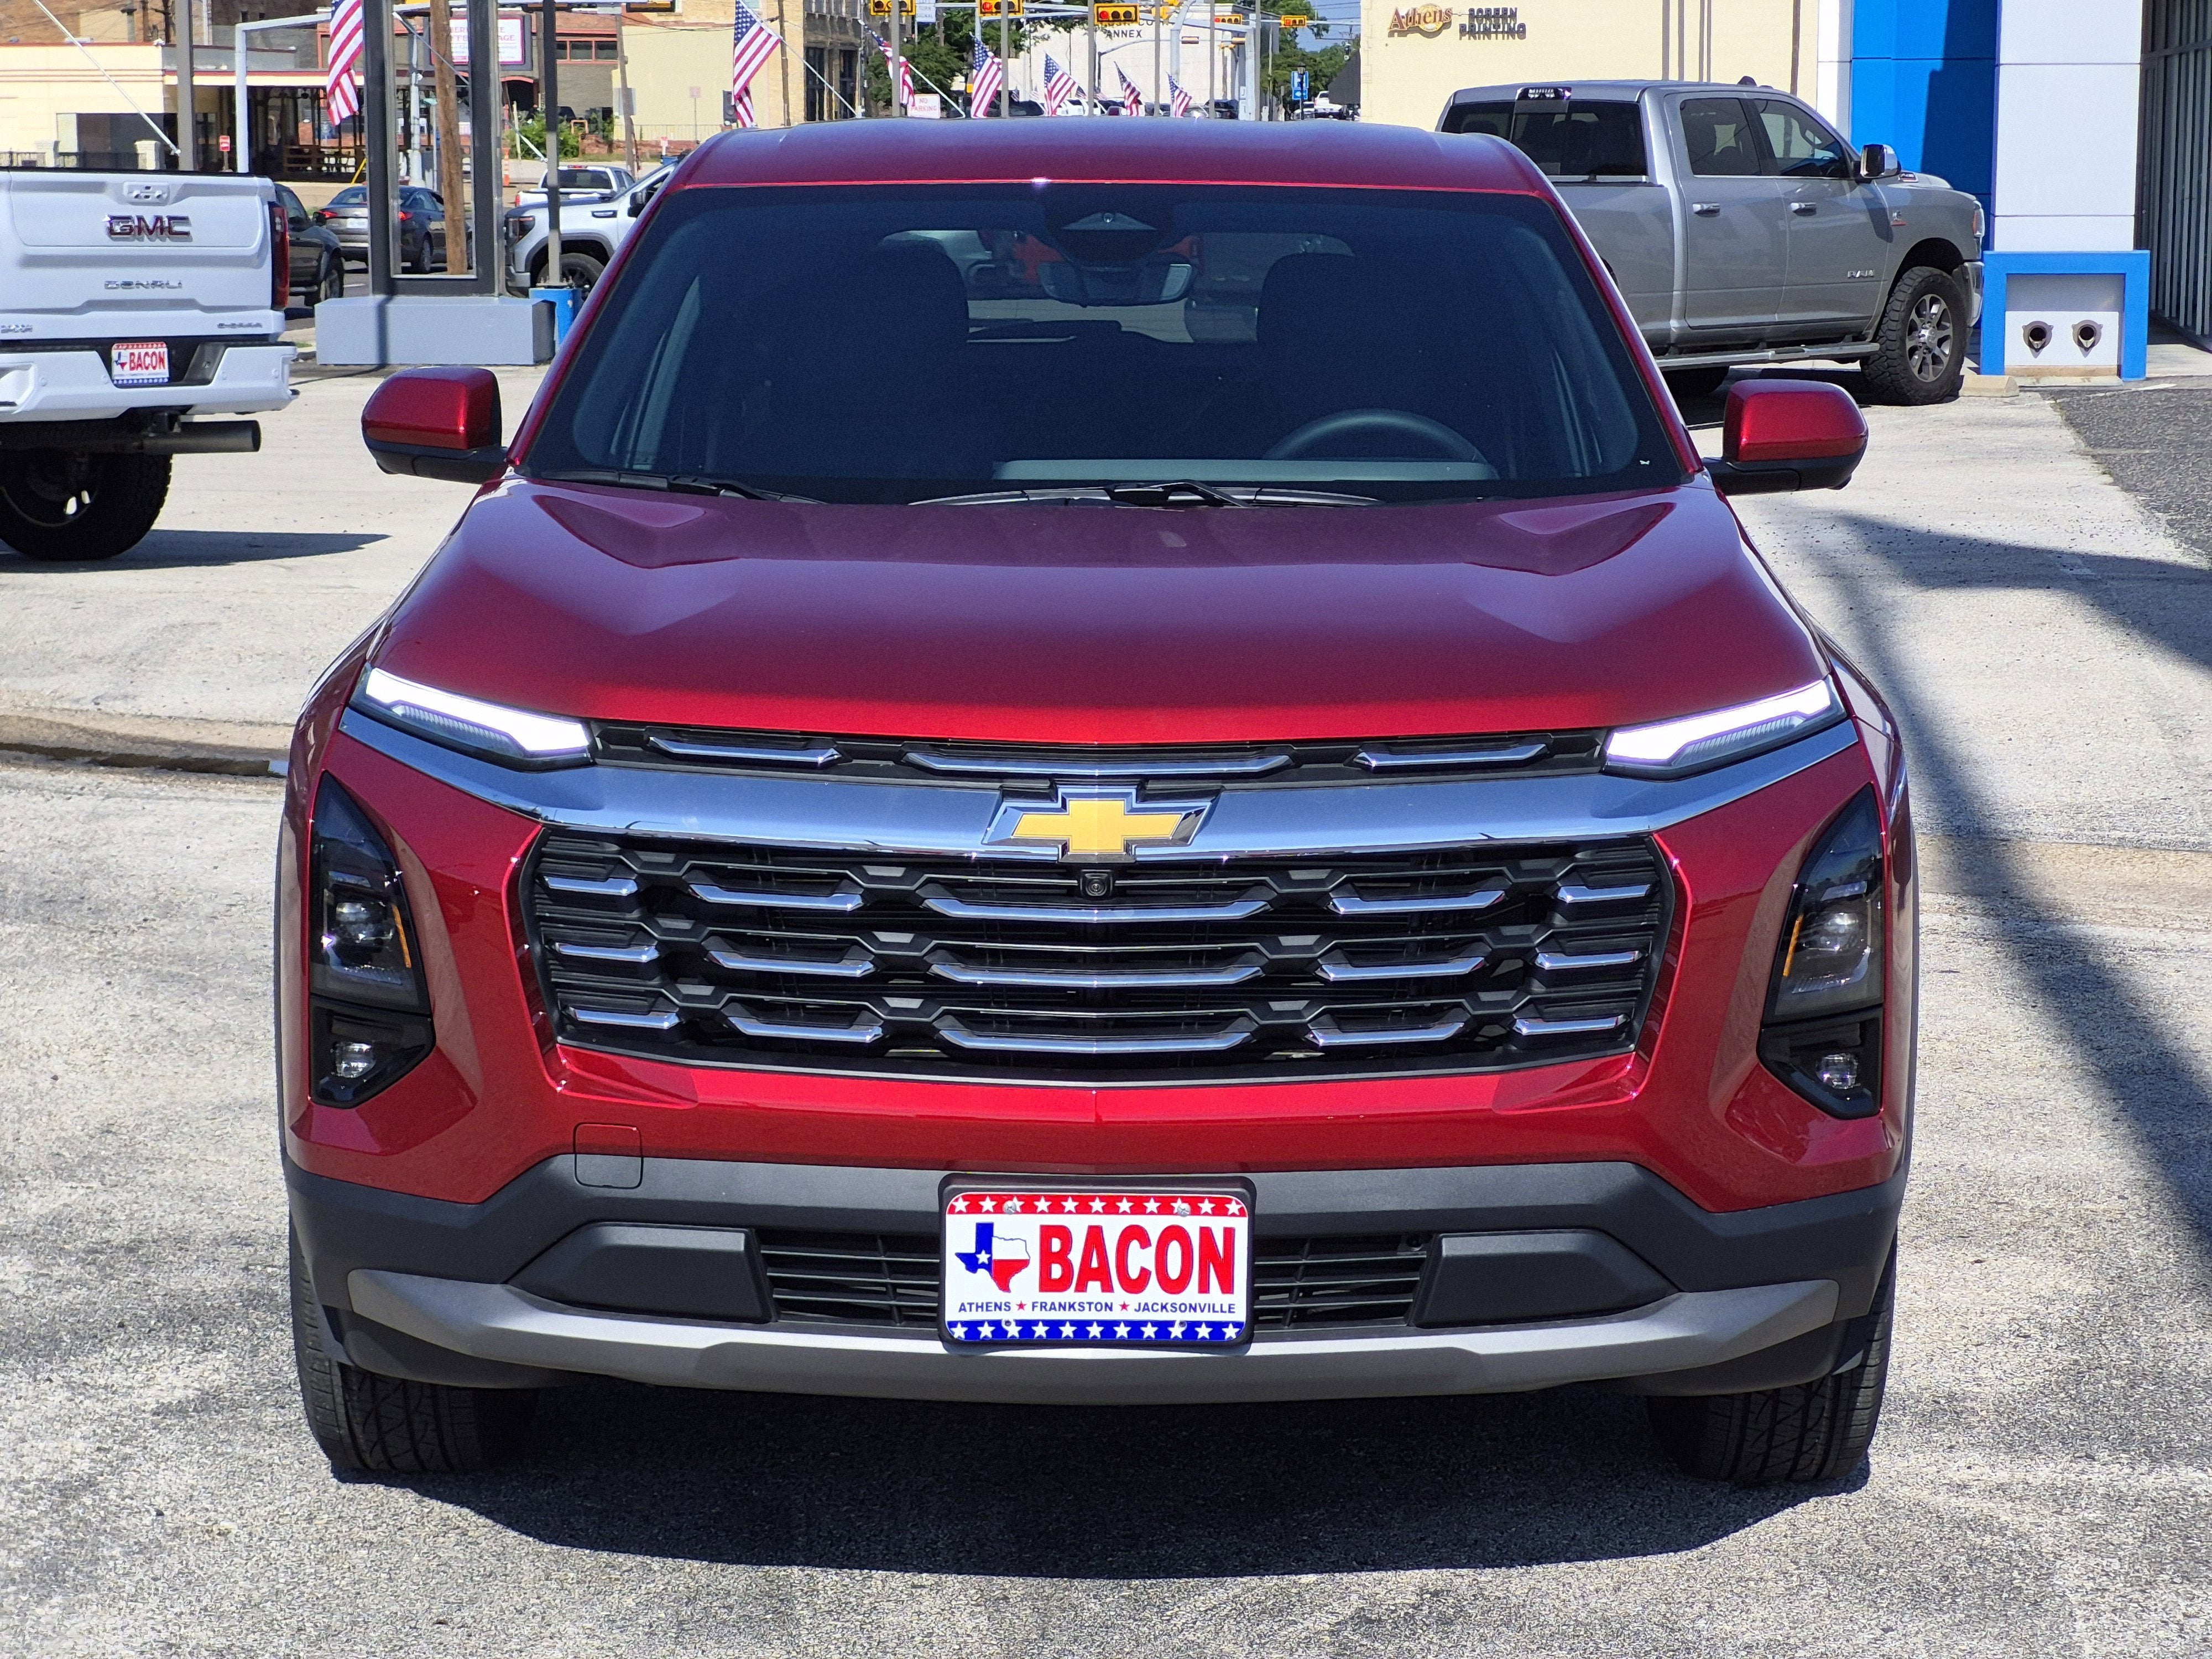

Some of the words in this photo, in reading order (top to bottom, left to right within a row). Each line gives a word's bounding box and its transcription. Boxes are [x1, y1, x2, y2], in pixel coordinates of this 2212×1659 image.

[1388, 6, 1453, 31] Athens
[1468, 7, 1517, 18] SCREEN
[1107, 29, 1142, 38] ANNEX
[1459, 23, 1527, 35] PRINTING
[107, 215, 191, 236] GMC
[104, 280, 182, 289] DENALI
[129, 351, 165, 371] BACON
[1039, 1224, 1236, 1295] BACON
[958, 1301, 1011, 1313] ATHENS
[1031, 1301, 1113, 1312] FRANKSTON
[1134, 1302, 1236, 1314] JACKSONVILLE
